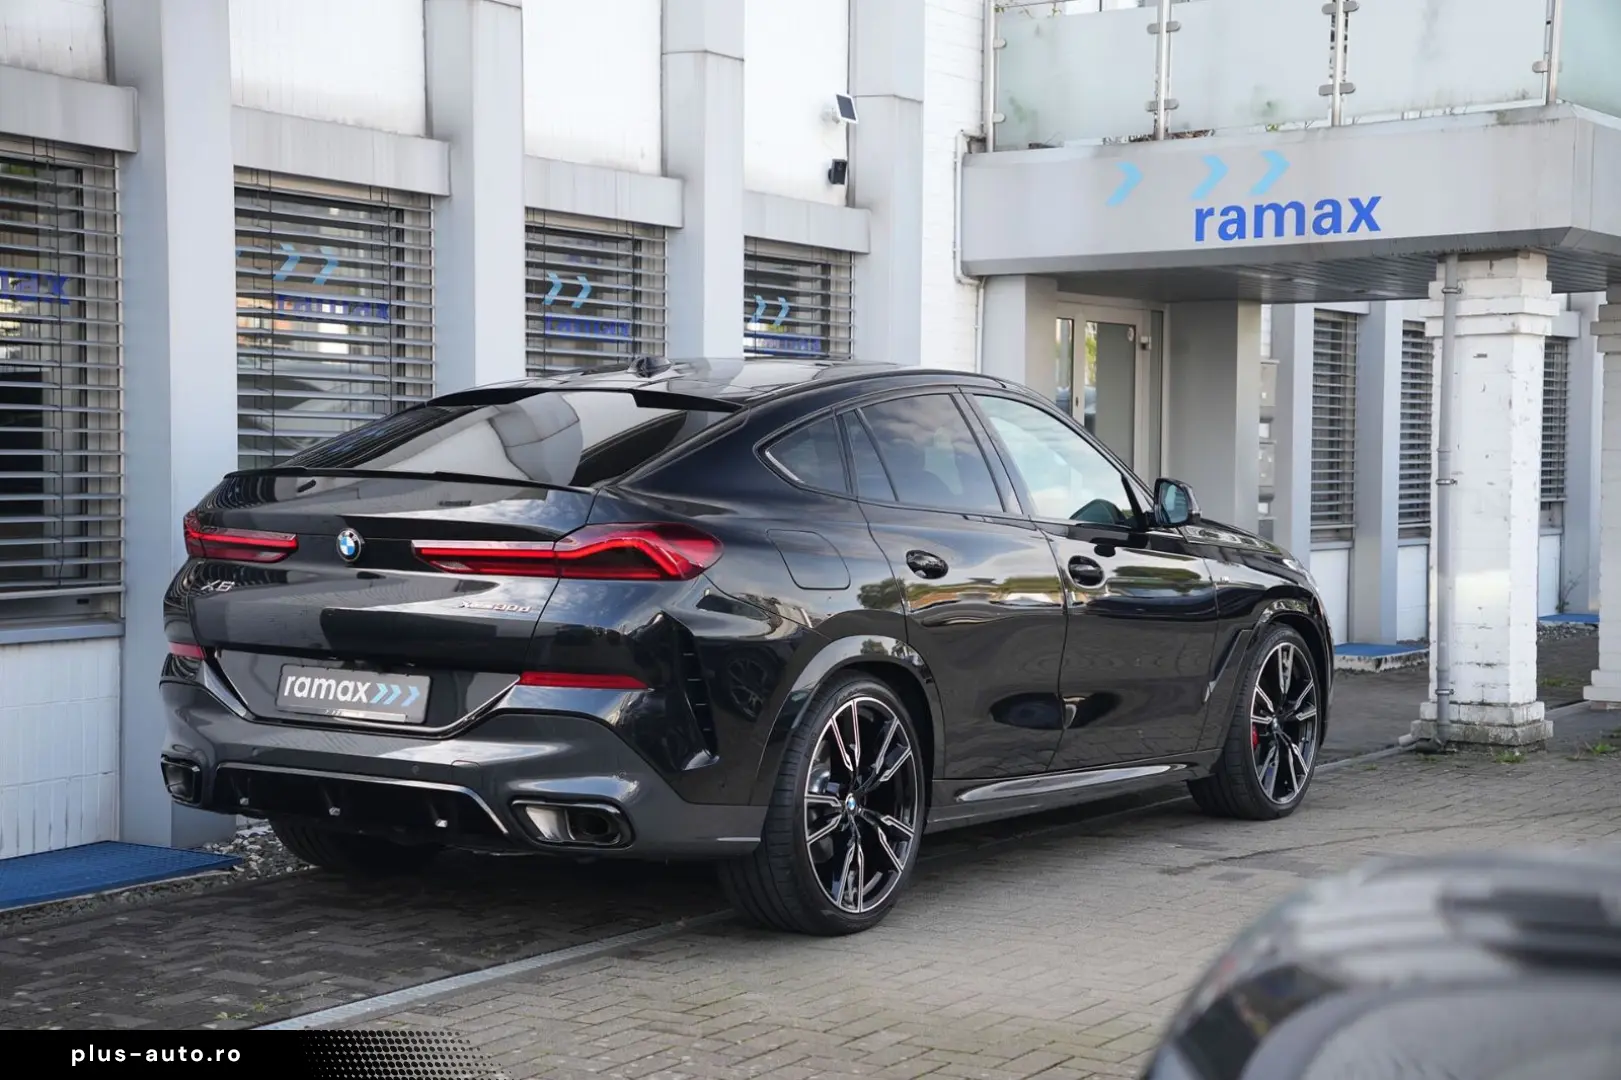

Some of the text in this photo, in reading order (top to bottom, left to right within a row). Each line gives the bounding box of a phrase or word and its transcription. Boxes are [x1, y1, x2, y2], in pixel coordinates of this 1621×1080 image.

[1194, 195, 1382, 242] ramax
[200, 579, 235, 592] X6
[283, 675, 372, 704] ramax
